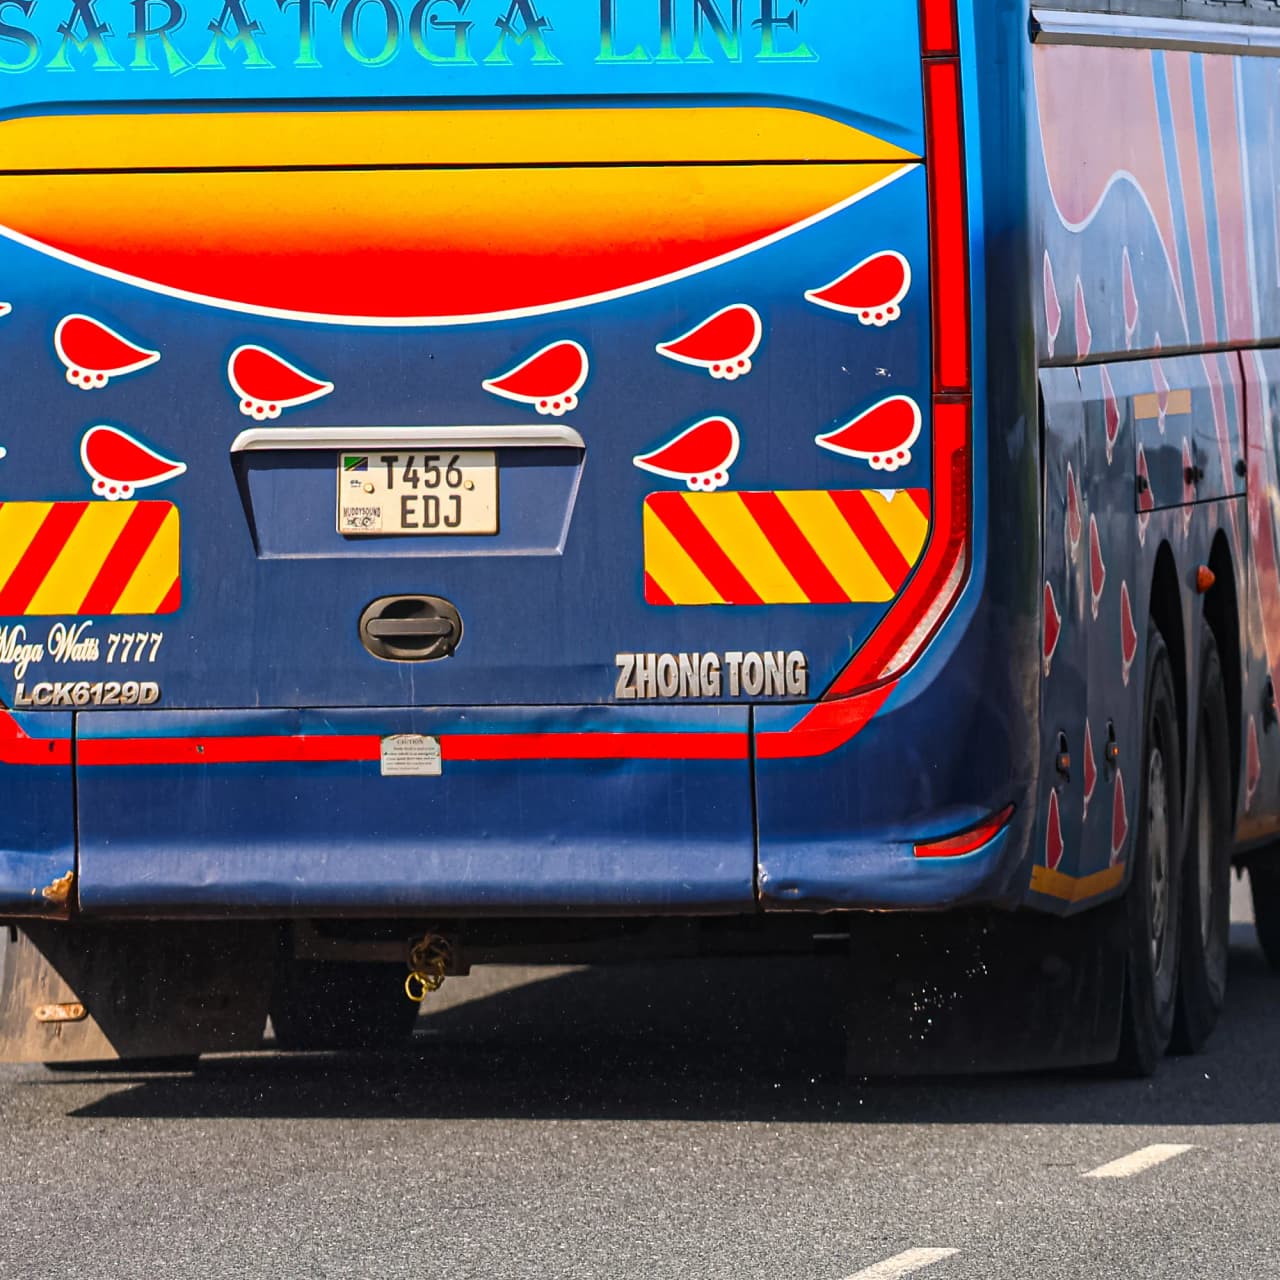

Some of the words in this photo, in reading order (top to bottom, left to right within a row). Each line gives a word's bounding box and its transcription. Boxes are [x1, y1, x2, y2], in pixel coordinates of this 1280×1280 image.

[381, 455, 463, 489] T456
[401, 495, 462, 528] EDJ
[47, 620, 100, 664] Watts
[106, 632, 163, 664] 7777
[615, 651, 721, 699] ZHONG
[725, 650, 807, 697] TONG
[14, 681, 161, 706] LCK6129D
